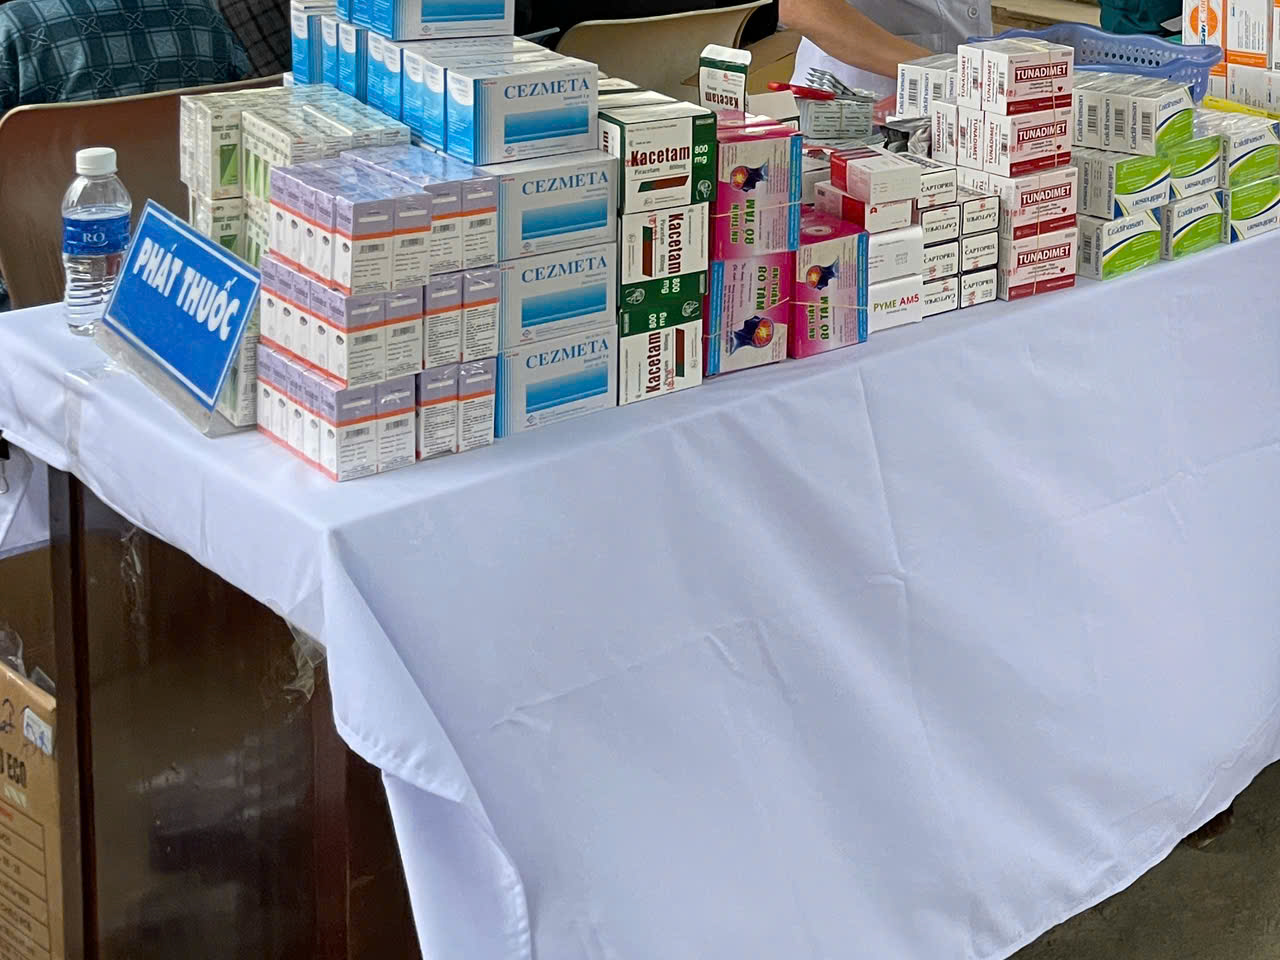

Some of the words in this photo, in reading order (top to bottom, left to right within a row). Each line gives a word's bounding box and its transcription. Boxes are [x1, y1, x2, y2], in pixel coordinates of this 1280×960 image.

[1015, 64, 1068, 80] TUNADIMET
[504, 78, 590, 100] CEZMETA
[705, 92, 739, 109] Kacetam
[1018, 123, 1067, 140] TUNADIMET
[631, 146, 690, 167] Kacetam
[694, 144, 708, 154] 800
[694, 155, 707, 164] mg
[521, 171, 608, 195] CEZMETA
[921, 181, 954, 193] CAPTOPRIL
[1021, 185, 1071, 203] TUNADIMET
[668, 212, 684, 275] Kacetam
[964, 243, 996, 256] CAPTOPRIL
[923, 252, 956, 264] CAPTOPRIL
[1018, 245, 1070, 265] TUNADIMET
[521, 255, 607, 283] CEZMETA
[133, 237, 184, 298] PHÁT
[176, 266, 241, 342] THUỐC
[661, 279, 670, 294] mg
[672, 278, 681, 293] 800
[963, 278, 994, 290] CAPTOPRIL
[873, 299, 897, 313] PYME
[899, 293, 920, 307] AM5
[648, 313, 657, 328] 800
[659, 312, 667, 327] mg
[525, 338, 609, 369] CEZMETA
[645, 331, 661, 394] Kacetam
